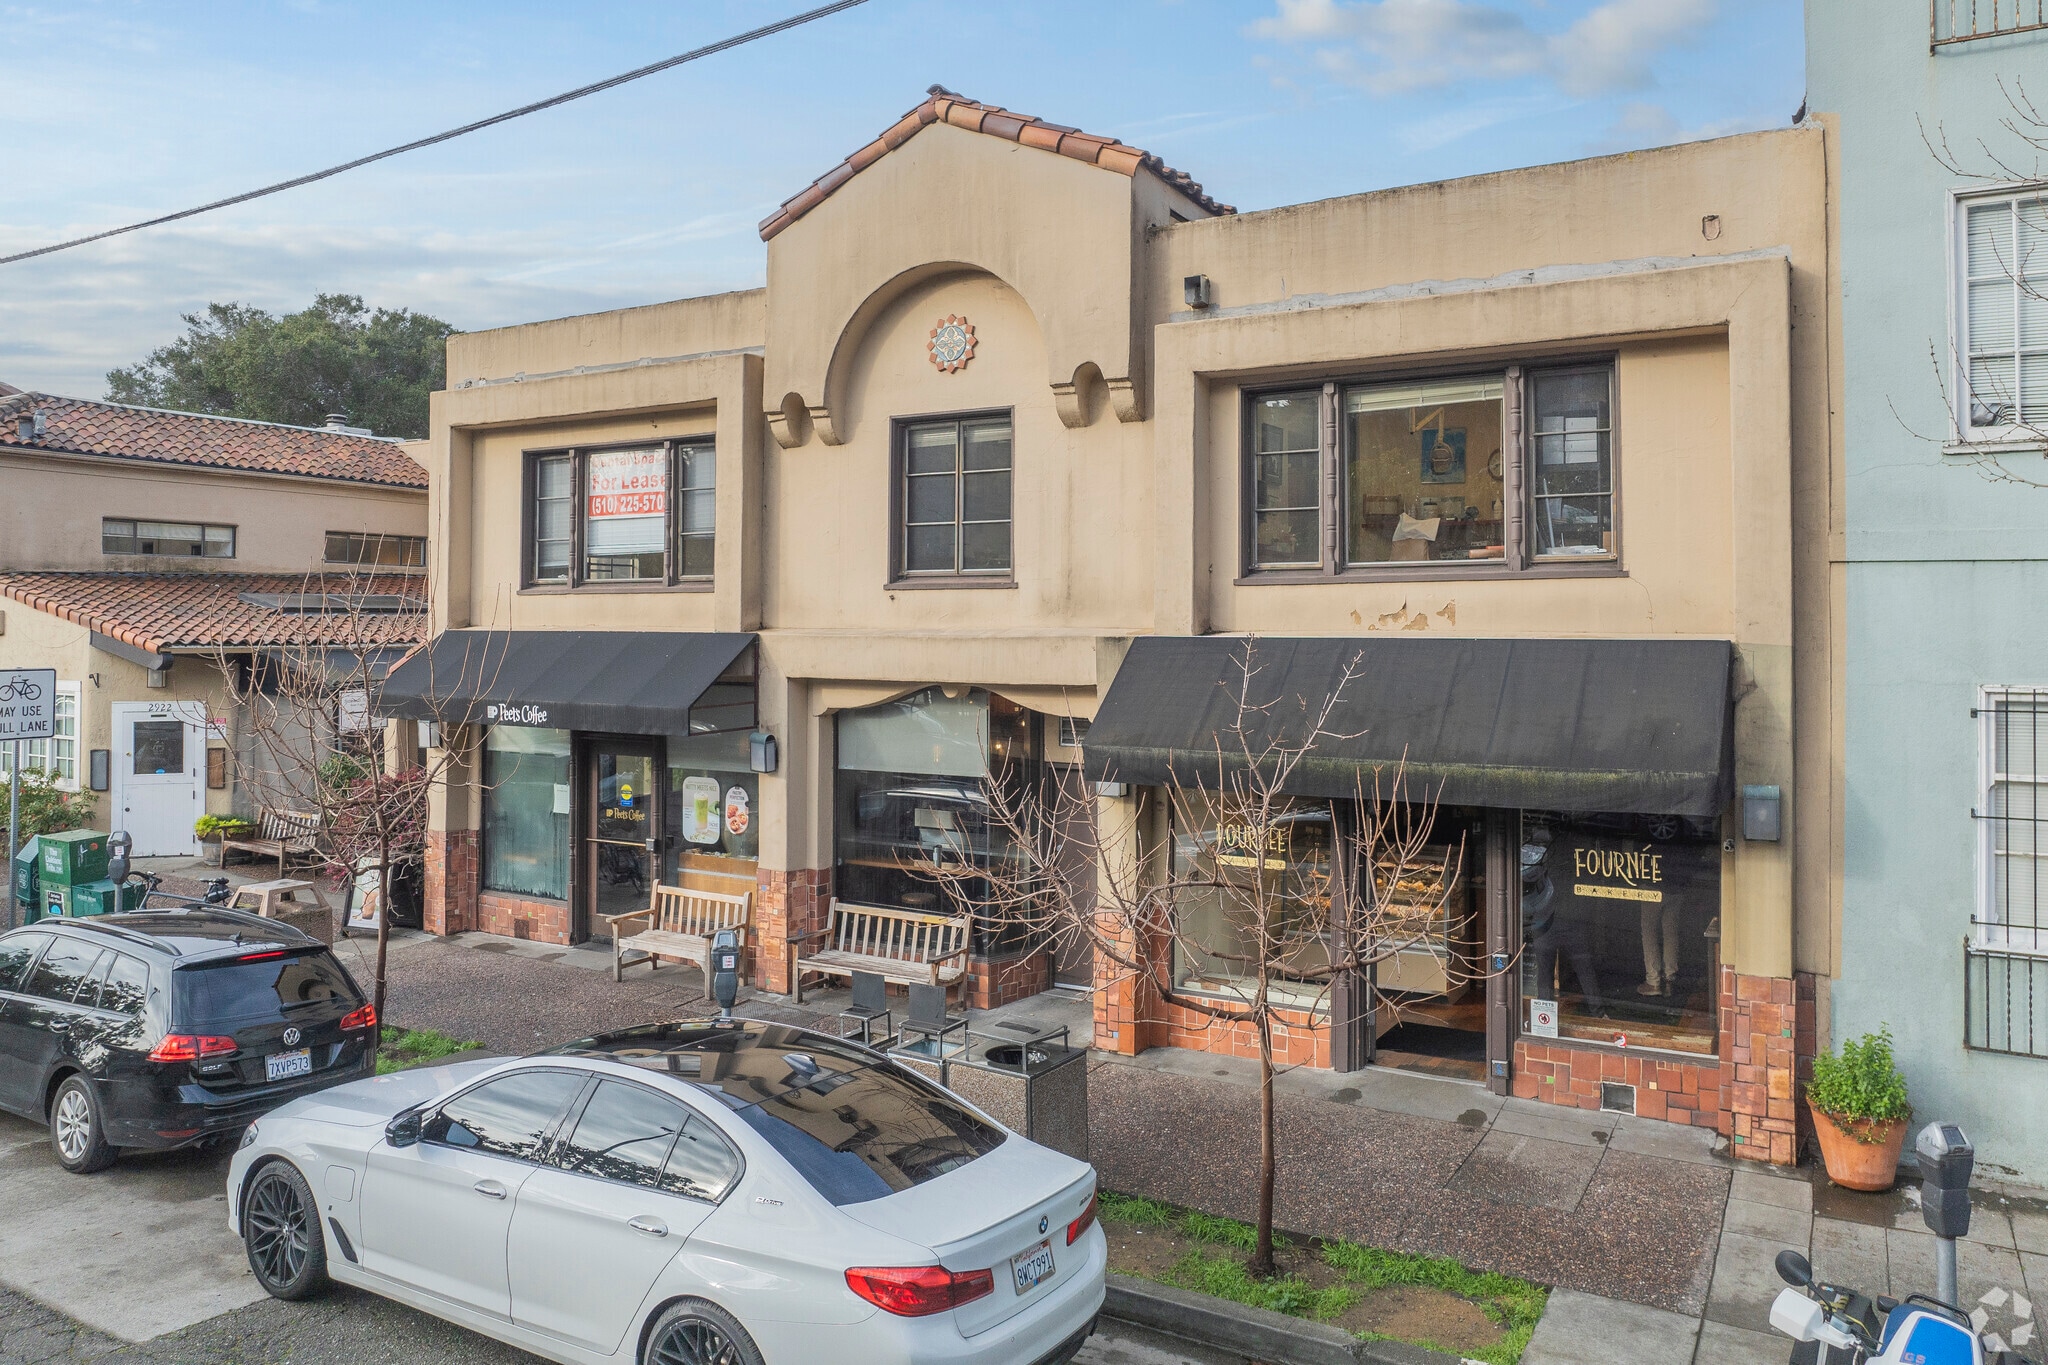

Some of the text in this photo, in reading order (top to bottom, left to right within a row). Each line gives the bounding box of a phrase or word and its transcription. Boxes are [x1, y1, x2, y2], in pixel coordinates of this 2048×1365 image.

[592, 474, 617, 491] For
[592, 494, 665, 514] (510) 225-570
[22, 705, 42, 716] USE
[148, 703, 172, 712] 2922
[521, 705, 548, 725] Coffee
[20, 720, 48, 732] LANE
[628, 809, 646, 822] Coffee
[1573, 843, 1663, 887] FOURNÉE
[1575, 886, 1660, 900] BAKERY
[268, 1056, 309, 1076] 7XVP573
[1016, 1252, 1052, 1286] 8WCT991
